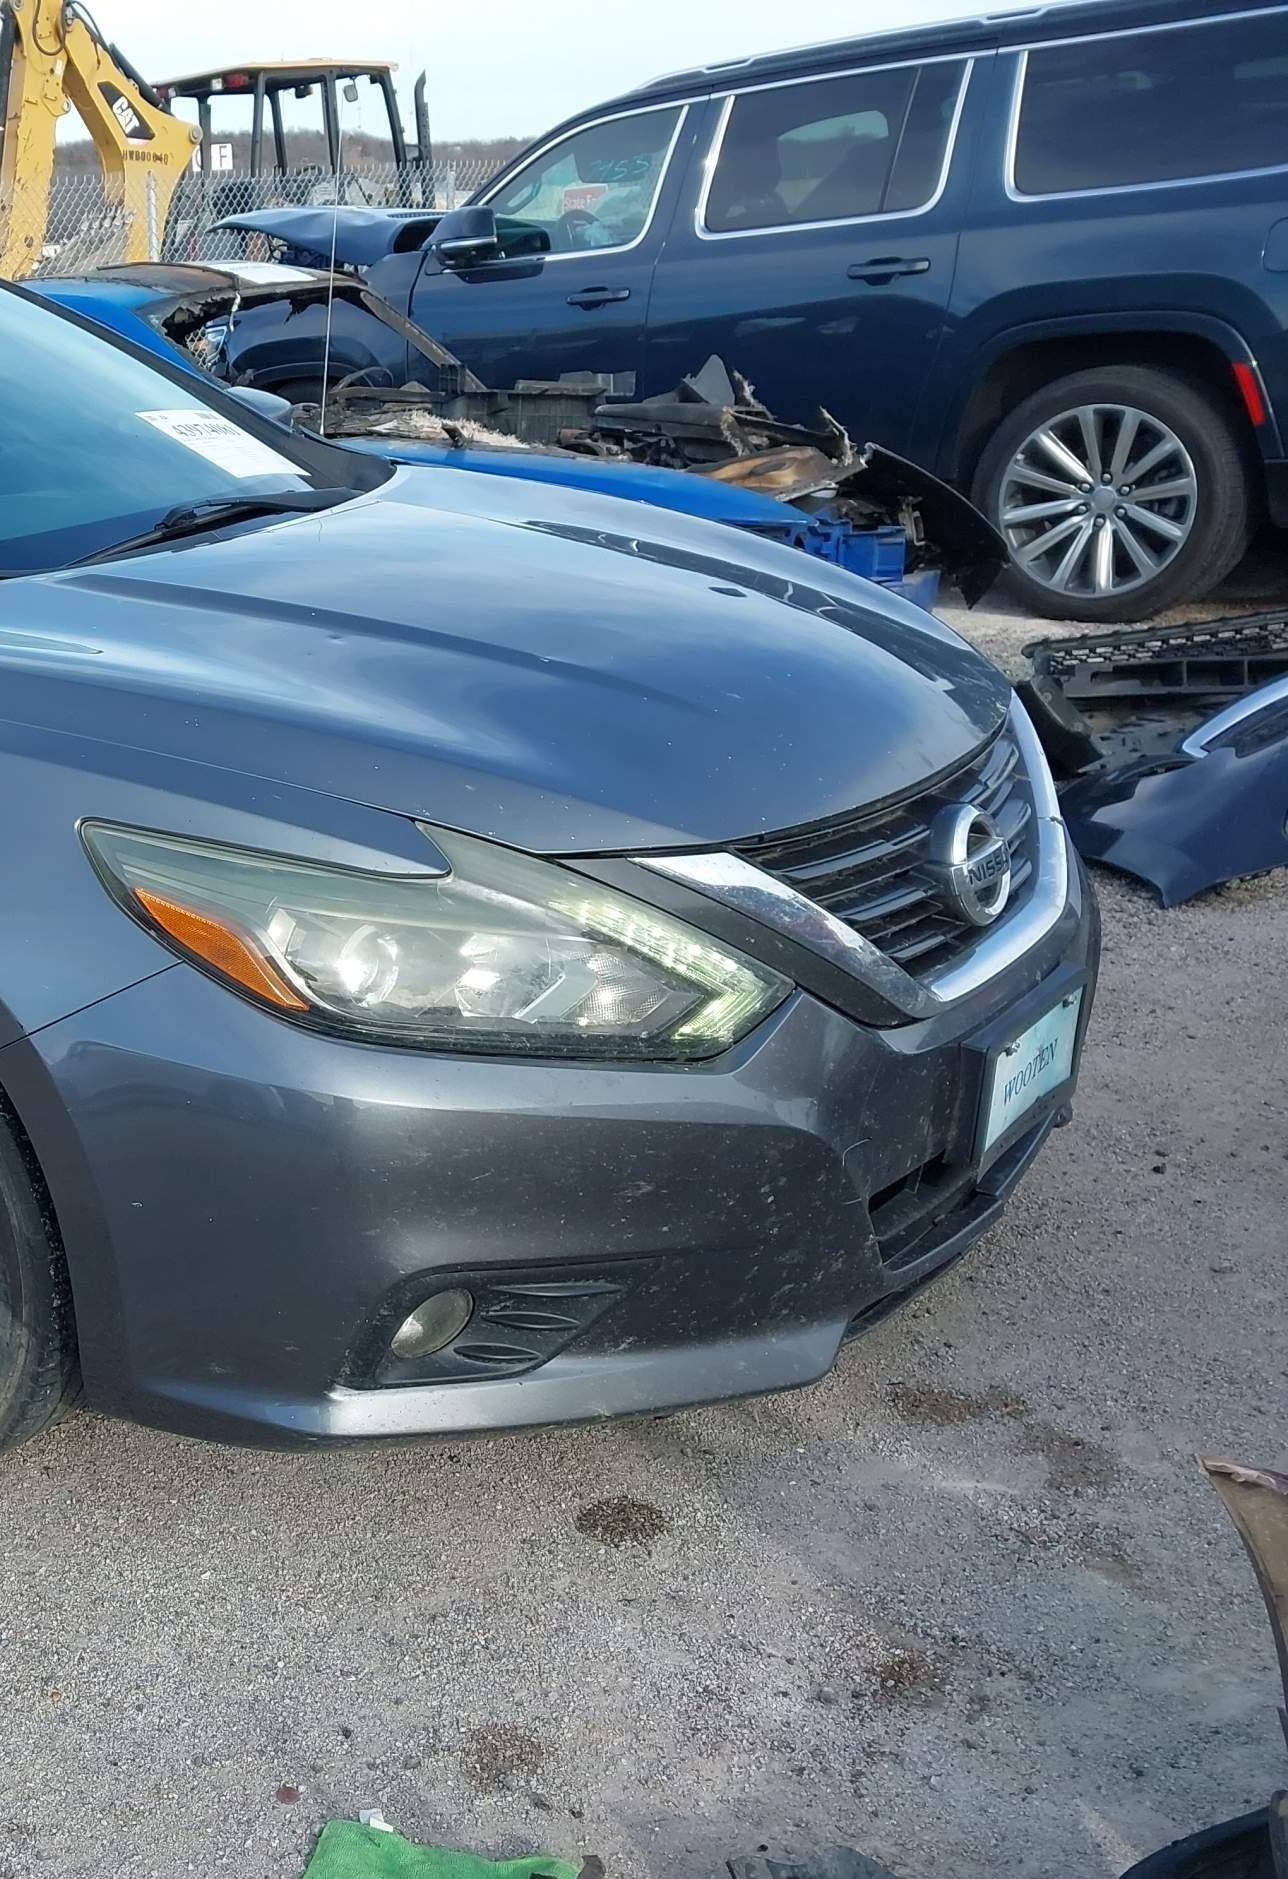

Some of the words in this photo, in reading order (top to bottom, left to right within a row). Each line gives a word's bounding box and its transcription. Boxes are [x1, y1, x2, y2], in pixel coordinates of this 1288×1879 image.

[112, 96, 140, 134] CAT
[219, 145, 227, 168] F
[968, 847, 1010, 886] NISS
[1003, 1037, 1059, 1106] WOOTEN
